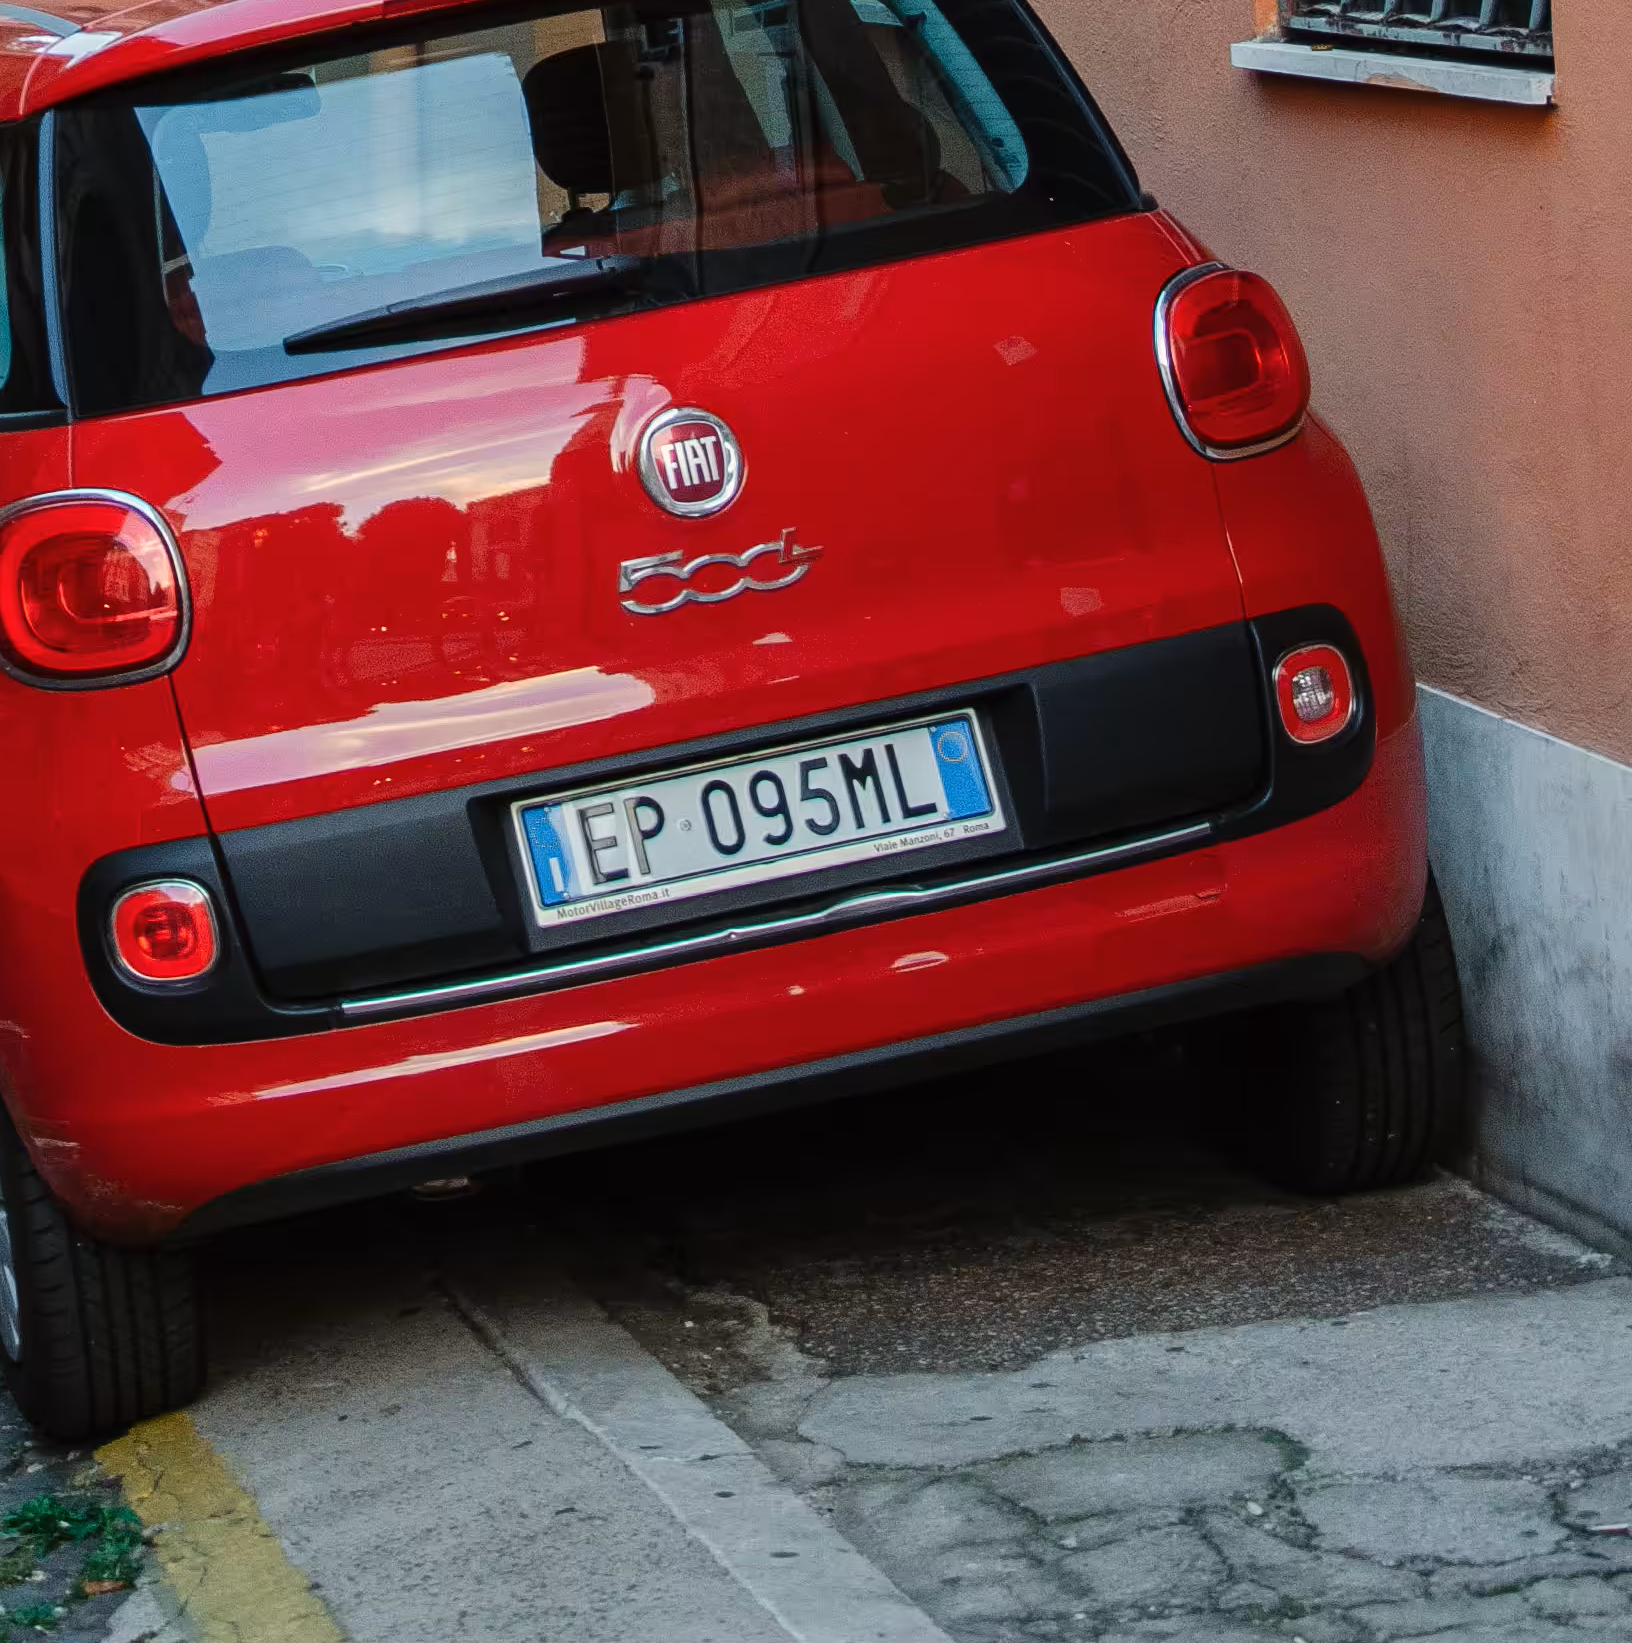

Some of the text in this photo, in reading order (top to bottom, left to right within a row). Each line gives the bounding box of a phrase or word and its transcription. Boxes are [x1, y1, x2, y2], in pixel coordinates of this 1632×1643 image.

[660, 435, 720, 490] FIAT
[576, 743, 938, 885] EP 095ML
[899, 831, 943, 848] Manzoni,
[962, 822, 990, 834] Roma
[556, 888, 670, 920] MotorVillageRoma.it
